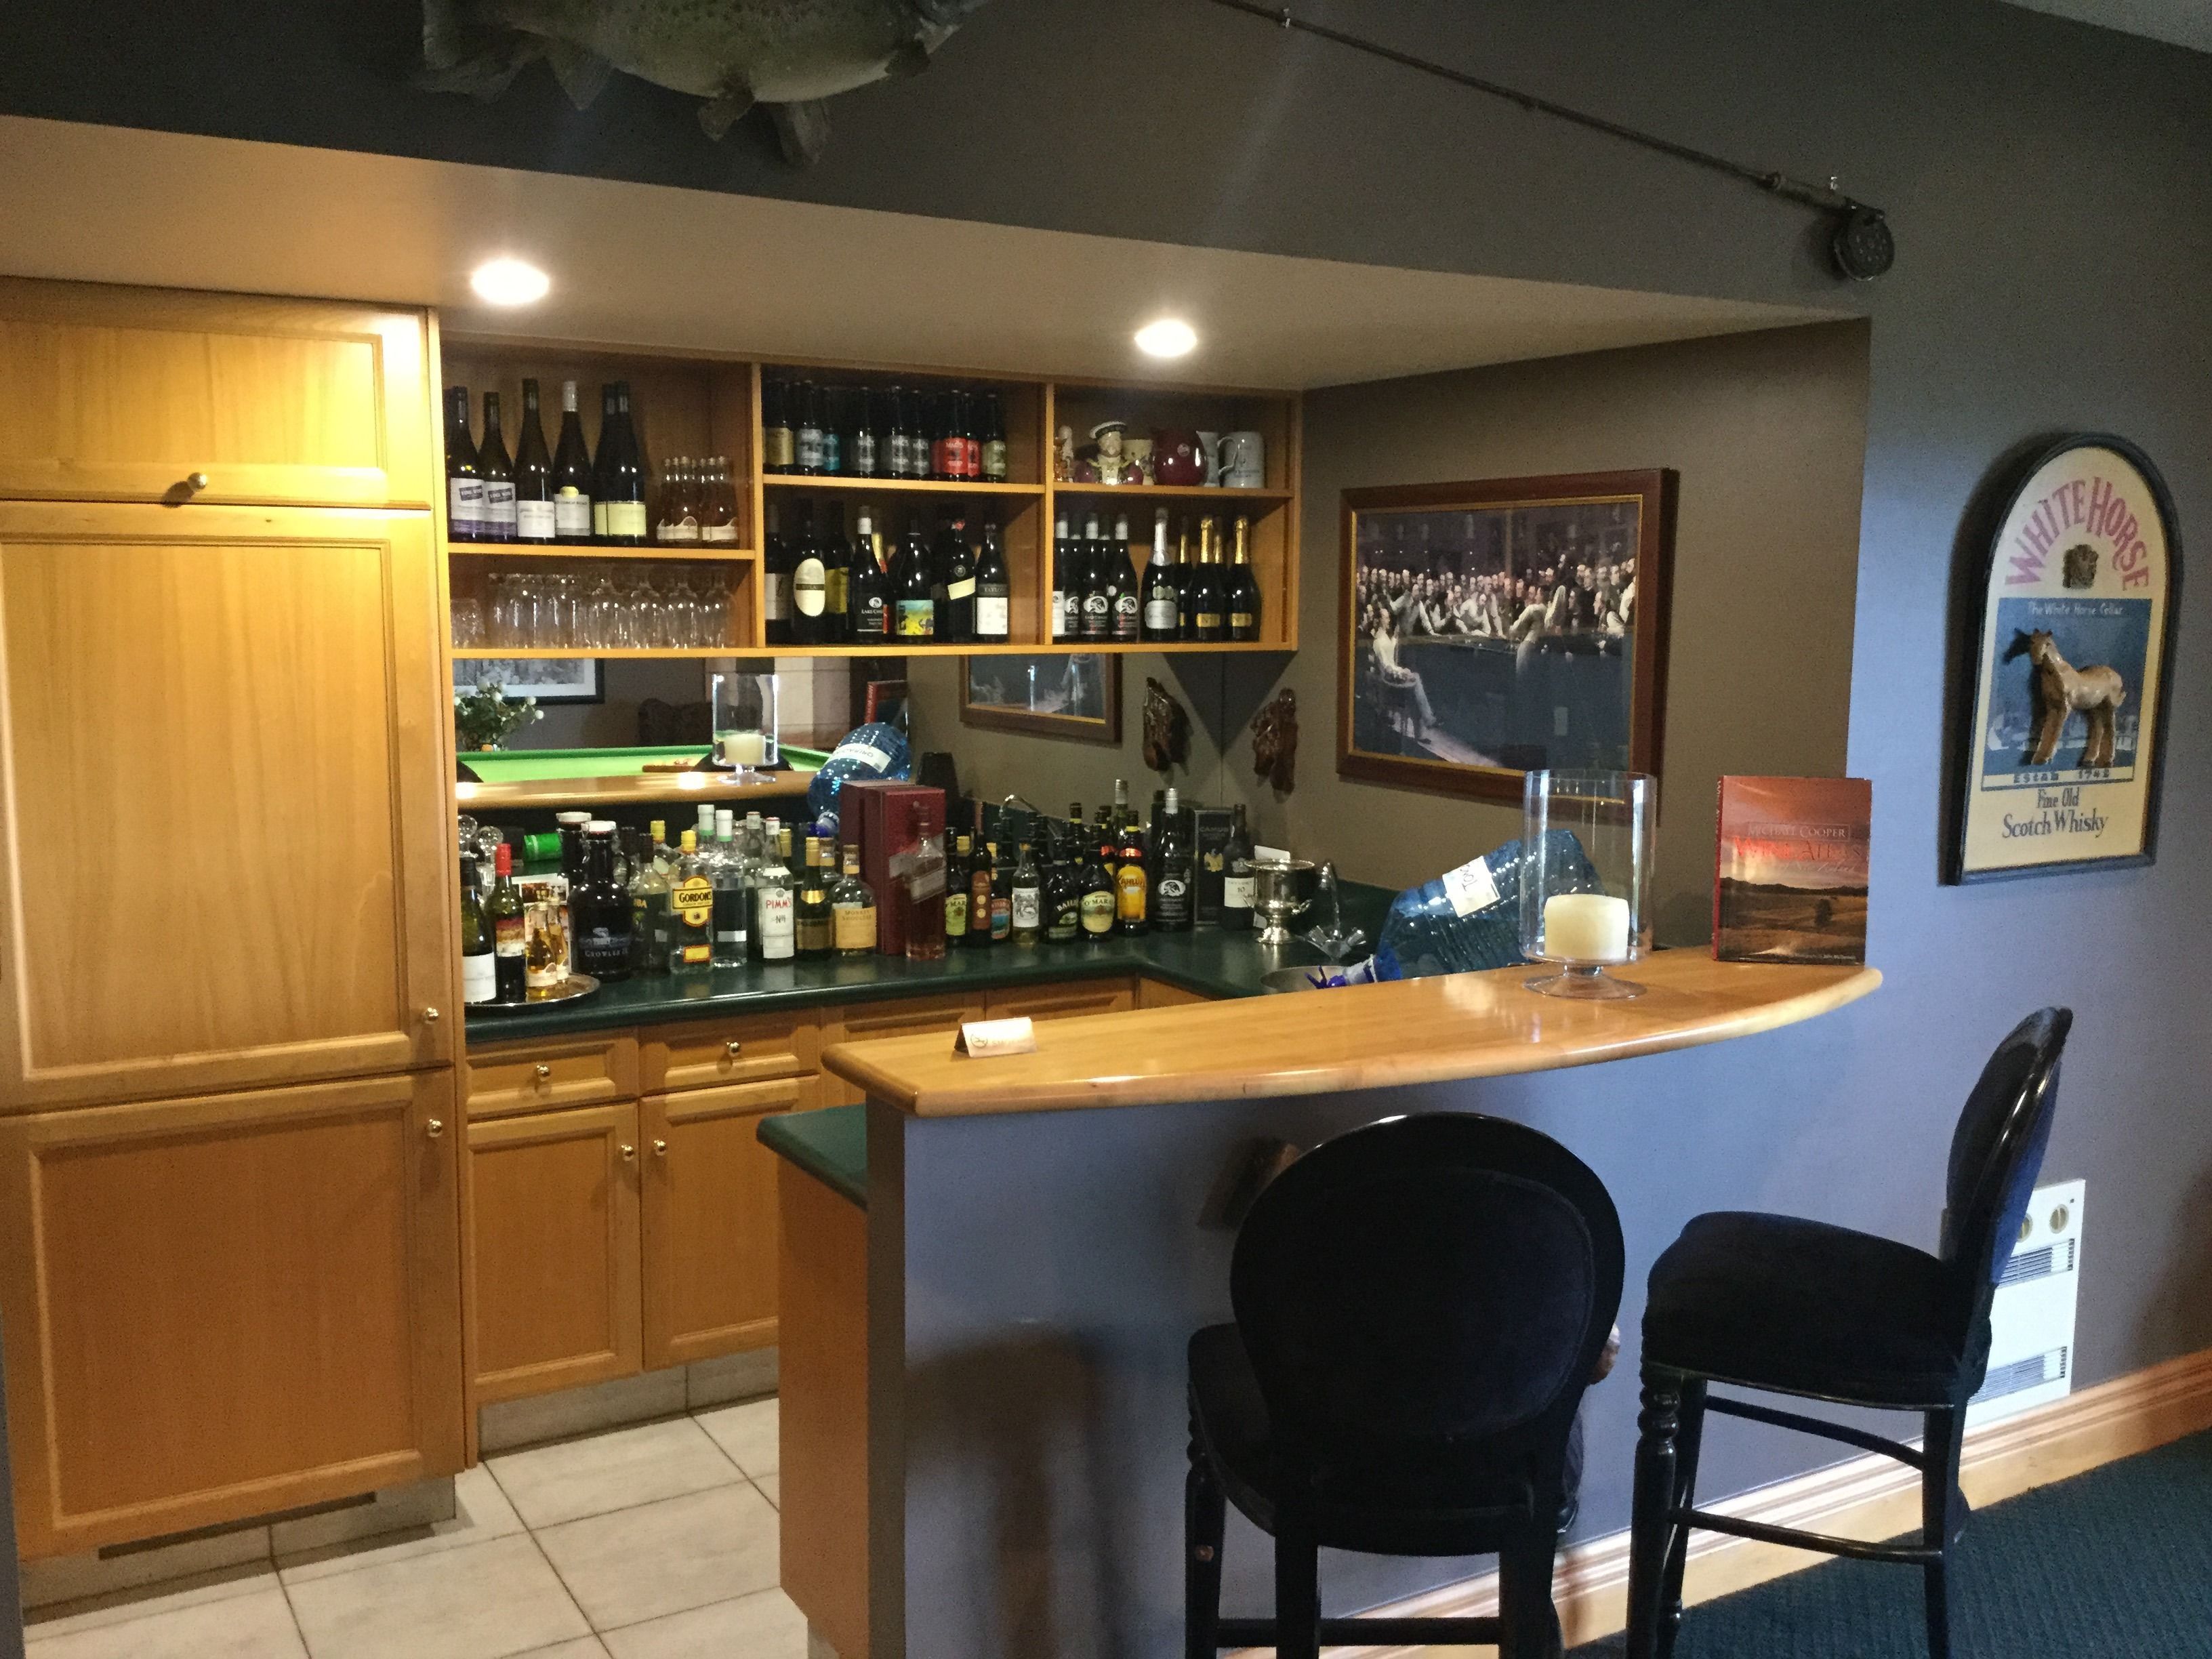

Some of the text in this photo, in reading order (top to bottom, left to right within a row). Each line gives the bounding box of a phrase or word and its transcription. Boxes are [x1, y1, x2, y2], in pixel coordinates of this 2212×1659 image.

[2005, 476, 2149, 591] WHITE HORSE
[2037, 787, 2080, 808] Fine Old
[1799, 826, 1846, 838] COOPER
[2002, 807, 2109, 838] Scotch Whisky
